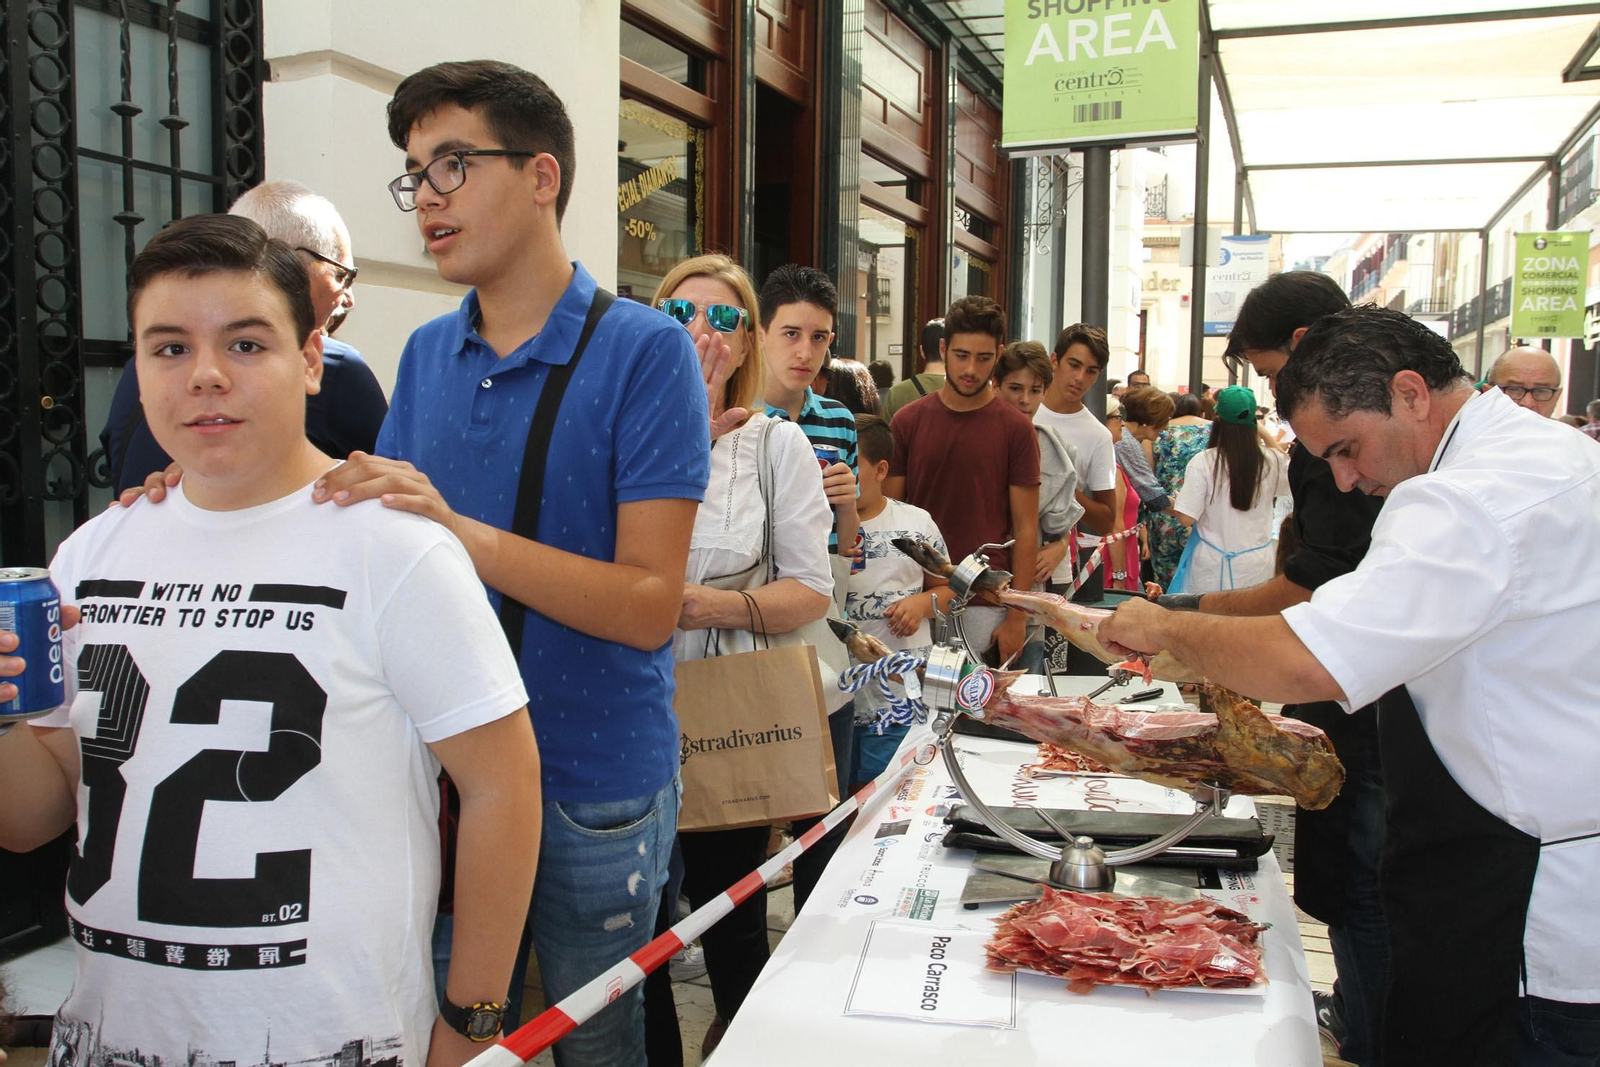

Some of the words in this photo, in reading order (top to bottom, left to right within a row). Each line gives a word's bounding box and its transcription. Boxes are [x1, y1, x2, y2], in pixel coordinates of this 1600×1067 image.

[1024, 8, 1177, 66] AREA
[618, 178, 641, 213] ECIAL
[625, 218, 656, 241] -50%
[1522, 257, 1580, 271] ZONA
[1522, 271, 1579, 280] COMERCIAL
[1521, 286, 1578, 296] SHOPPING
[1519, 296, 1578, 312] AREA
[151, 582, 204, 601] WITH
[211, 583, 242, 602] NO
[78, 604, 166, 626] FRONTIER
[178, 608, 206, 628] TO
[214, 608, 275, 629] STOP
[285, 610, 315, 631] US
[42, 598, 64, 684] pepsi
[916, 864, 932, 887] TRUCCO
[262, 913, 277, 924] BT.
[279, 903, 302, 921] 02
[929, 936, 952, 960] Paco
[920, 962, 948, 1011] Carrasco
